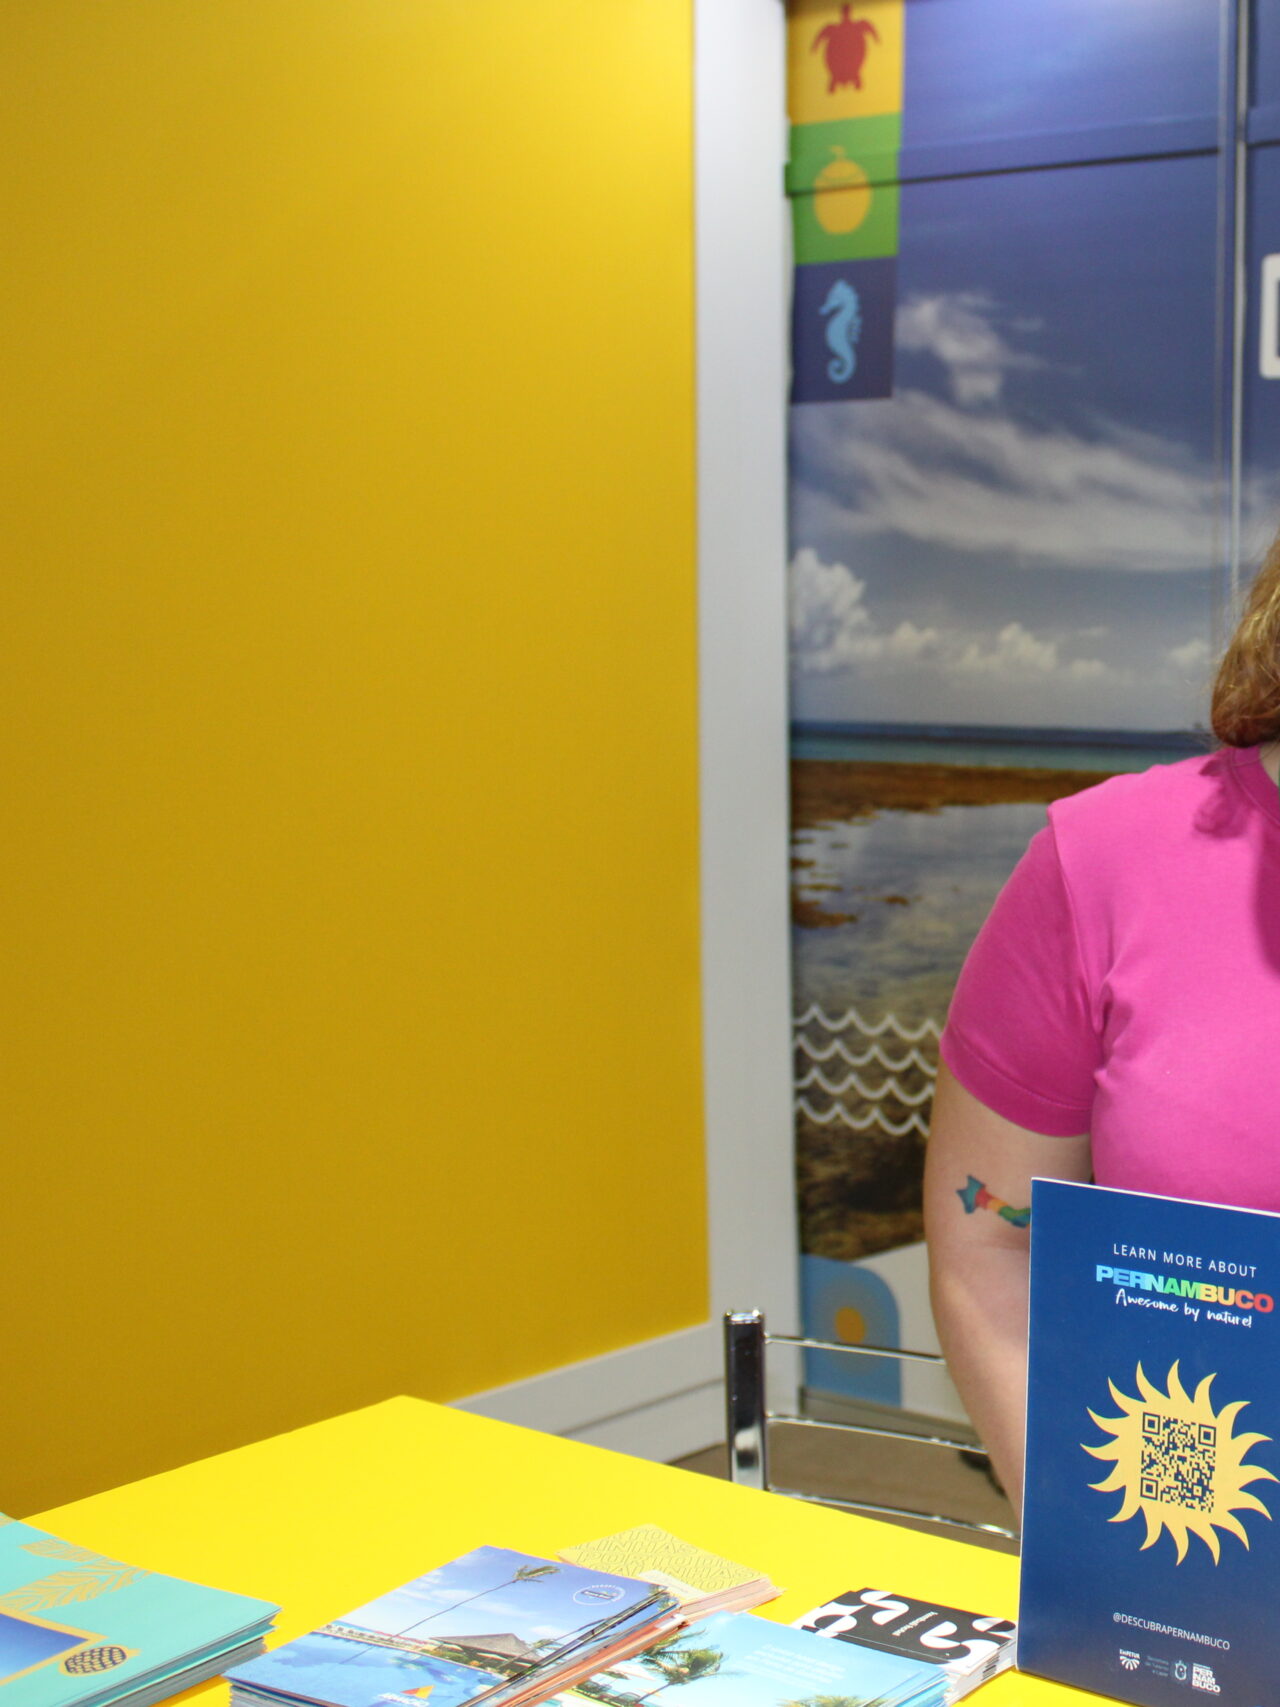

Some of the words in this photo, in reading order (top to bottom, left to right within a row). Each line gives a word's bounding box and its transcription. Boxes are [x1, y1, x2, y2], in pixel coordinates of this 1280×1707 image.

[1113, 1243, 1157, 1262] LEARN
[1163, 1251, 1203, 1270] MORE
[1208, 1259, 1257, 1279] ABOUT
[1095, 1264, 1275, 1314] PERNAMBUCO
[1115, 1287, 1179, 1313] Awesome
[1183, 1303, 1200, 1322] by
[1112, 1611, 1231, 1651] @DESCUBRAPERNAMBUCO
